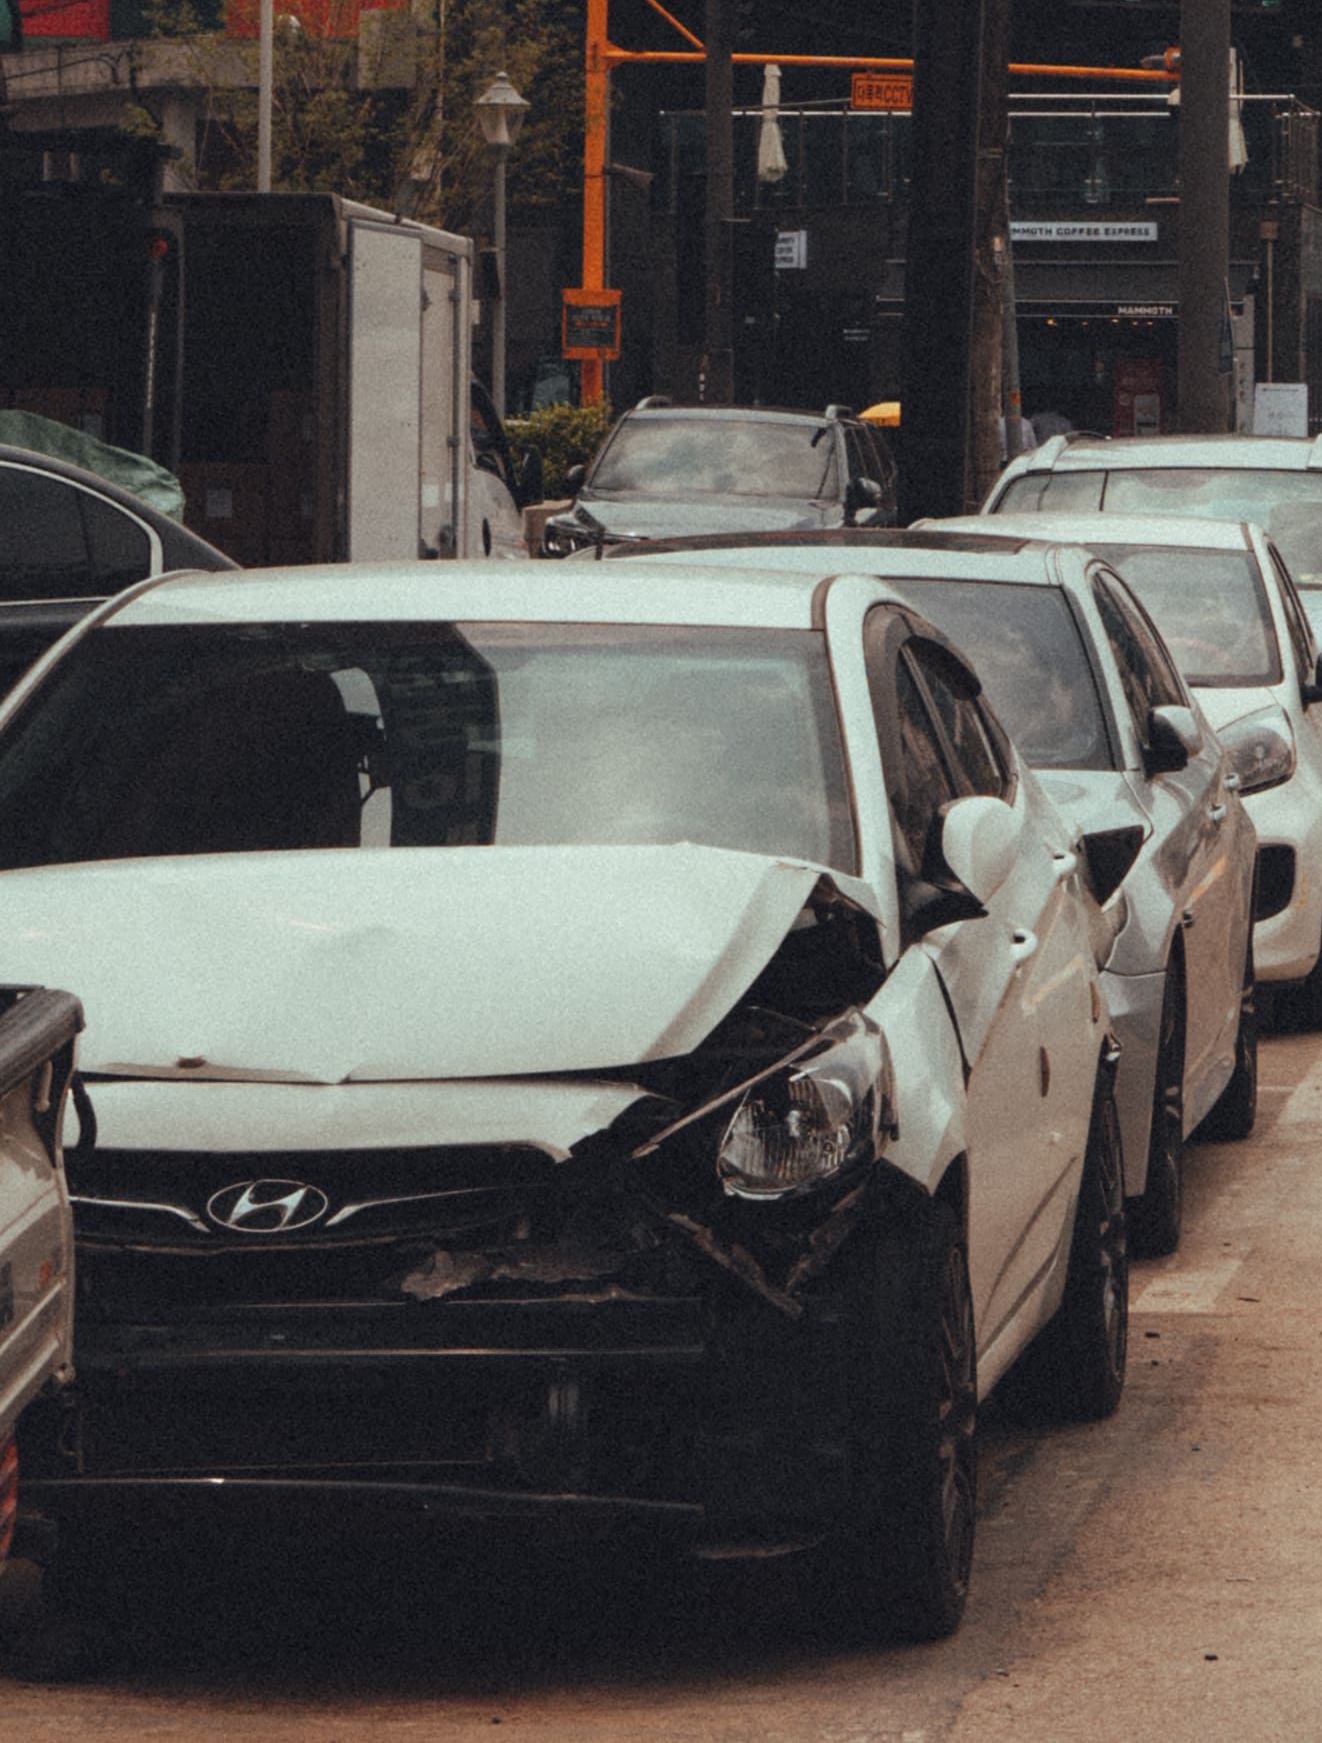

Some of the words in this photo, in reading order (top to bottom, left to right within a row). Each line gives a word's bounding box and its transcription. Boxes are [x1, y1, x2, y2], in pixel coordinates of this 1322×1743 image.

[1011, 226, 1053, 237] MMOTH
[1056, 226, 1100, 237] COFFEE
[1104, 226, 1151, 237] EXPRESS
[1117, 305, 1174, 316] MAMMOTH
